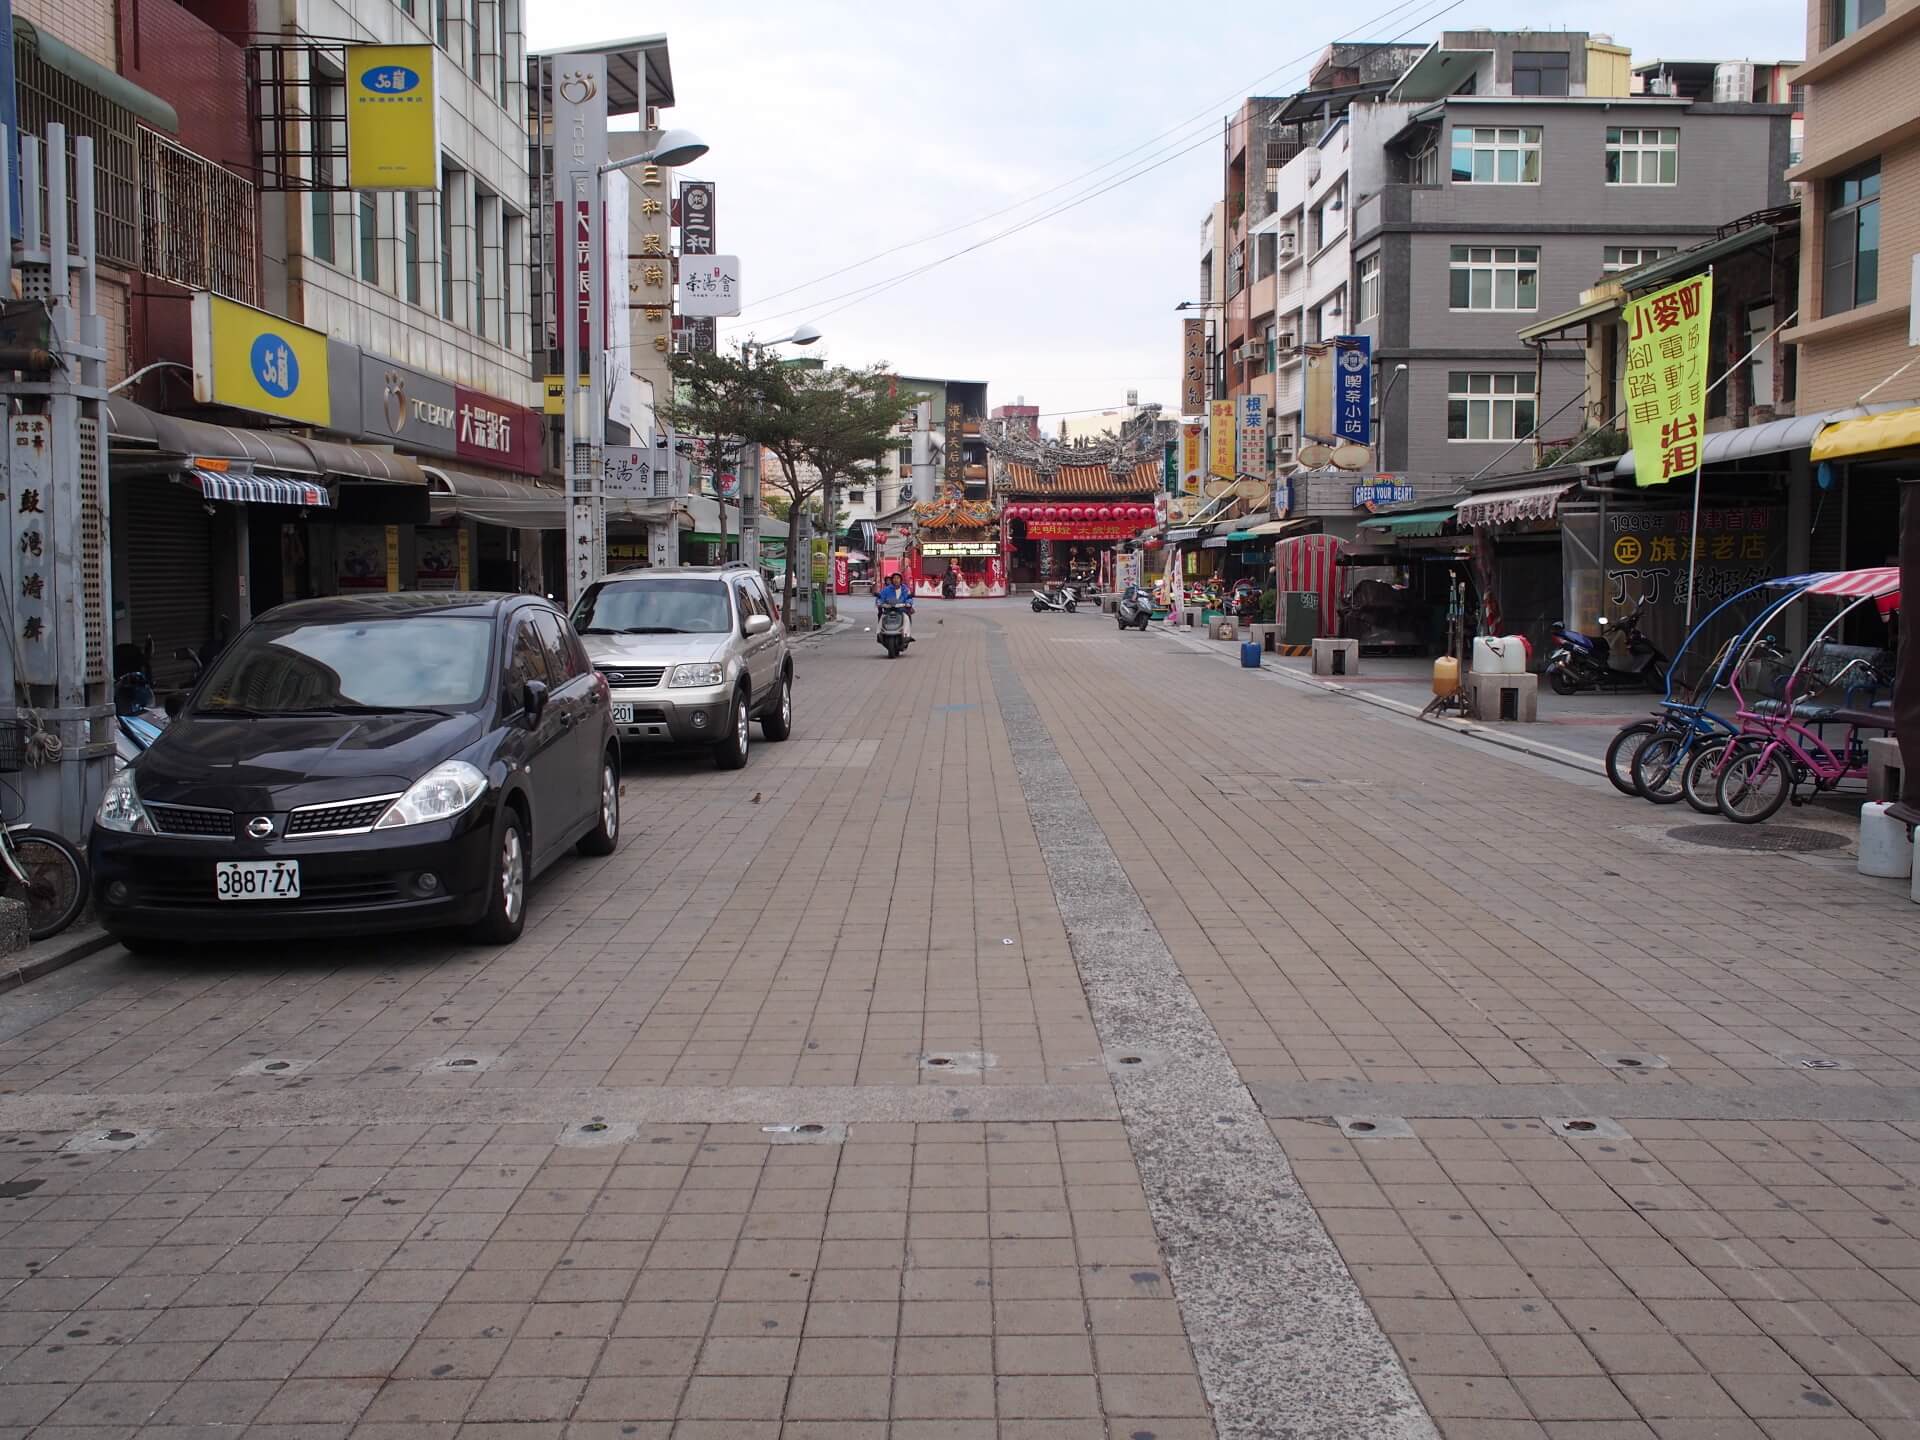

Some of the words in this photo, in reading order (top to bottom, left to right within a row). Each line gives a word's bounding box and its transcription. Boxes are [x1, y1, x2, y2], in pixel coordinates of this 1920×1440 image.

[375, 70, 406, 90] 50嵐
[686, 272, 736, 293] 茶湯會
[1631, 282, 1703, 341] 小麥町
[262, 344, 290, 392] 50嵐
[1627, 344, 1662, 424] 腳踏車
[1659, 334, 1685, 416] 電動車
[460, 403, 510, 453] 大眾銀行
[1345, 375, 1362, 433] 喫茶小站
[1661, 413, 1698, 478] 出租
[1356, 487, 1375, 504] GREEN
[1376, 487, 1392, 499] YOUR
[1393, 487, 1412, 502] HEART
[1649, 535, 1767, 562] 旗津老店
